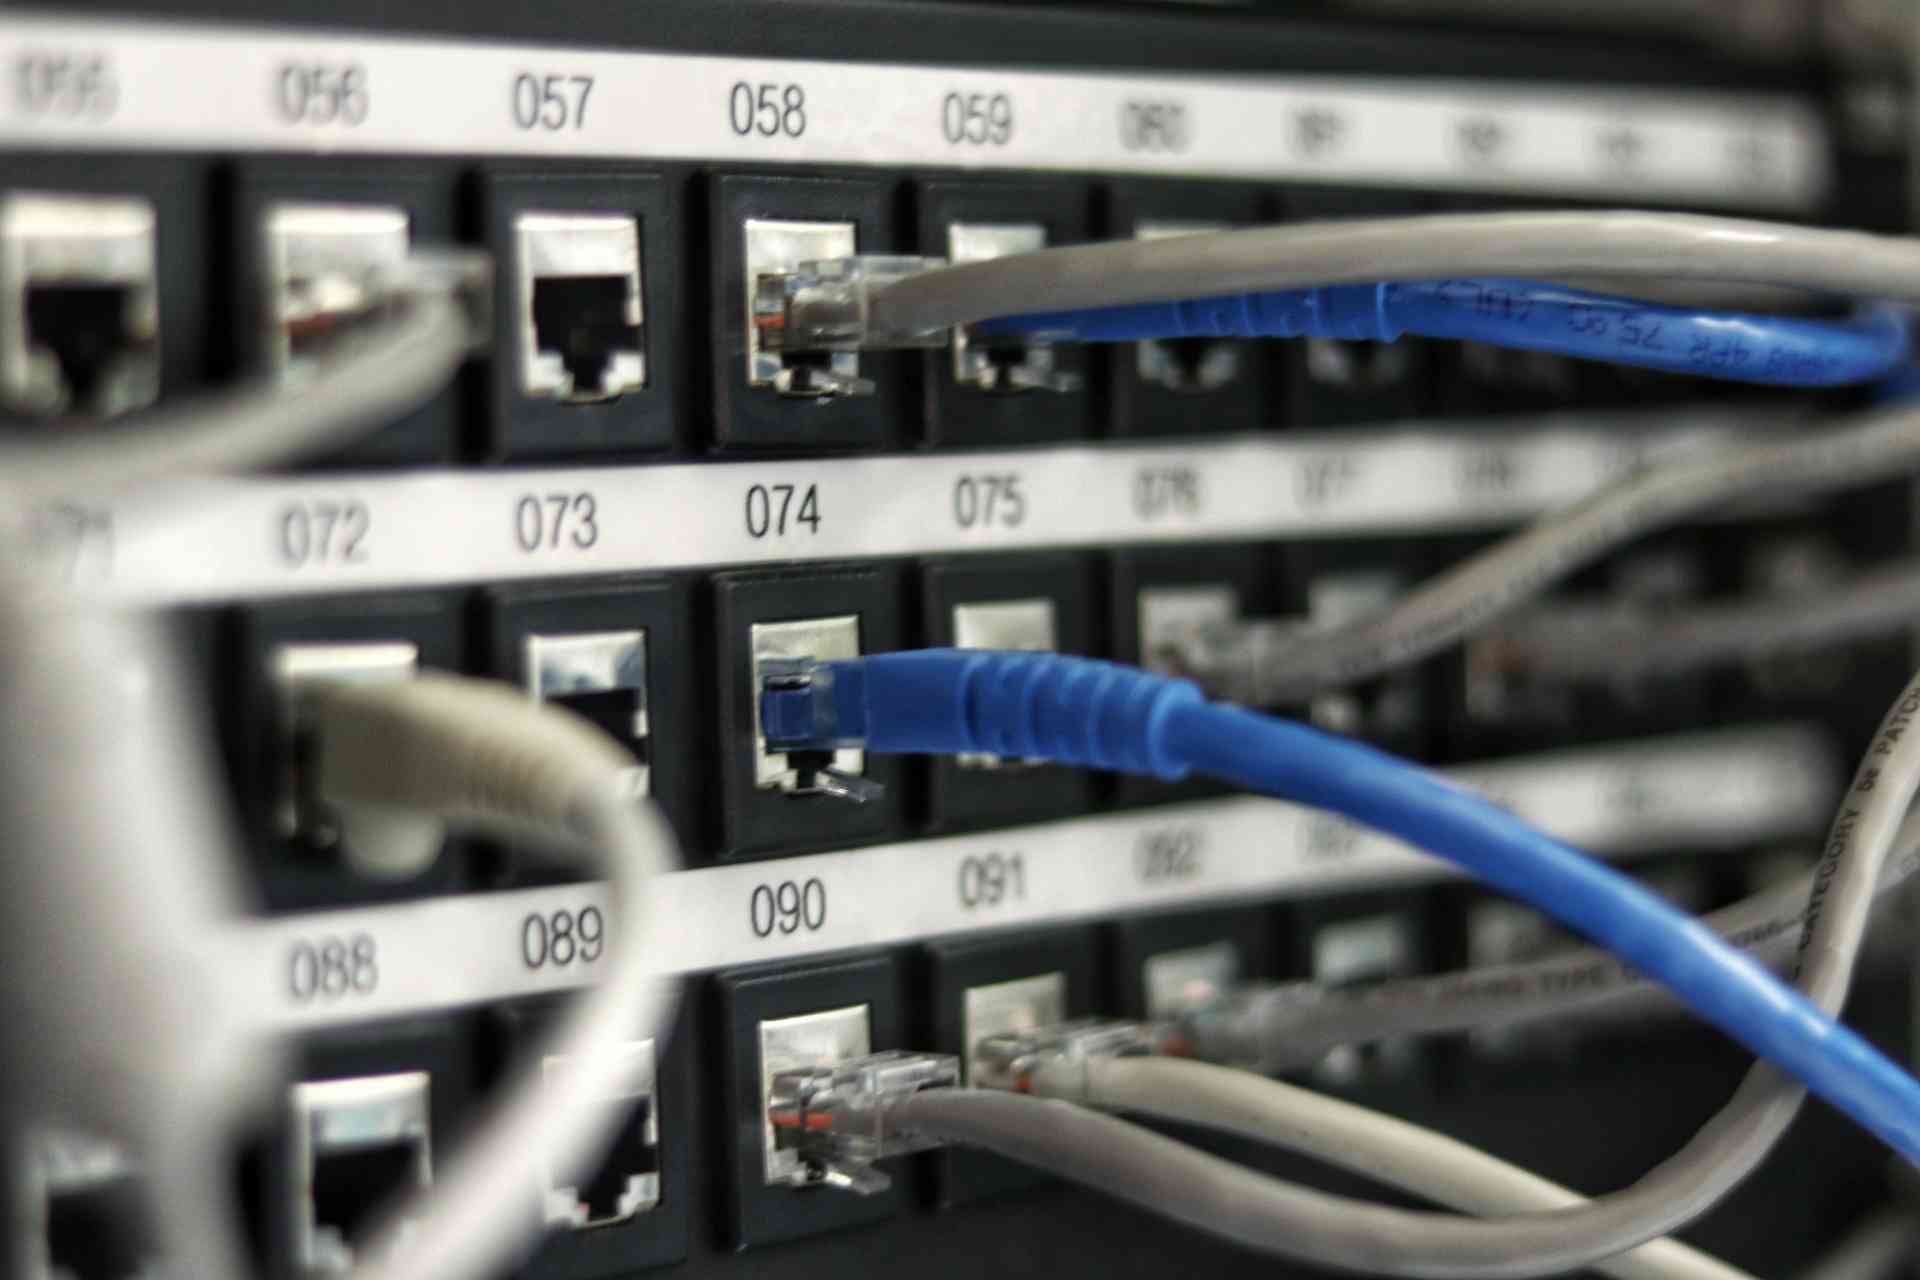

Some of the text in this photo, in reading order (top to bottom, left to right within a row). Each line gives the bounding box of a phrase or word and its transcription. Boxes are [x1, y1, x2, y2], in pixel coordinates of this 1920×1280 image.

[275, 64, 368, 125] 056
[513, 73, 594, 130] 057
[729, 80, 807, 137] 058
[942, 91, 1014, 146] 059
[281, 500, 371, 567] 072
[515, 492, 599, 553] 073
[745, 483, 822, 538] 074
[953, 474, 1027, 529] 075
[288, 934, 379, 1000] 088
[522, 905, 605, 970] 089
[750, 877, 828, 938] 090
[957, 850, 1027, 908] 091
